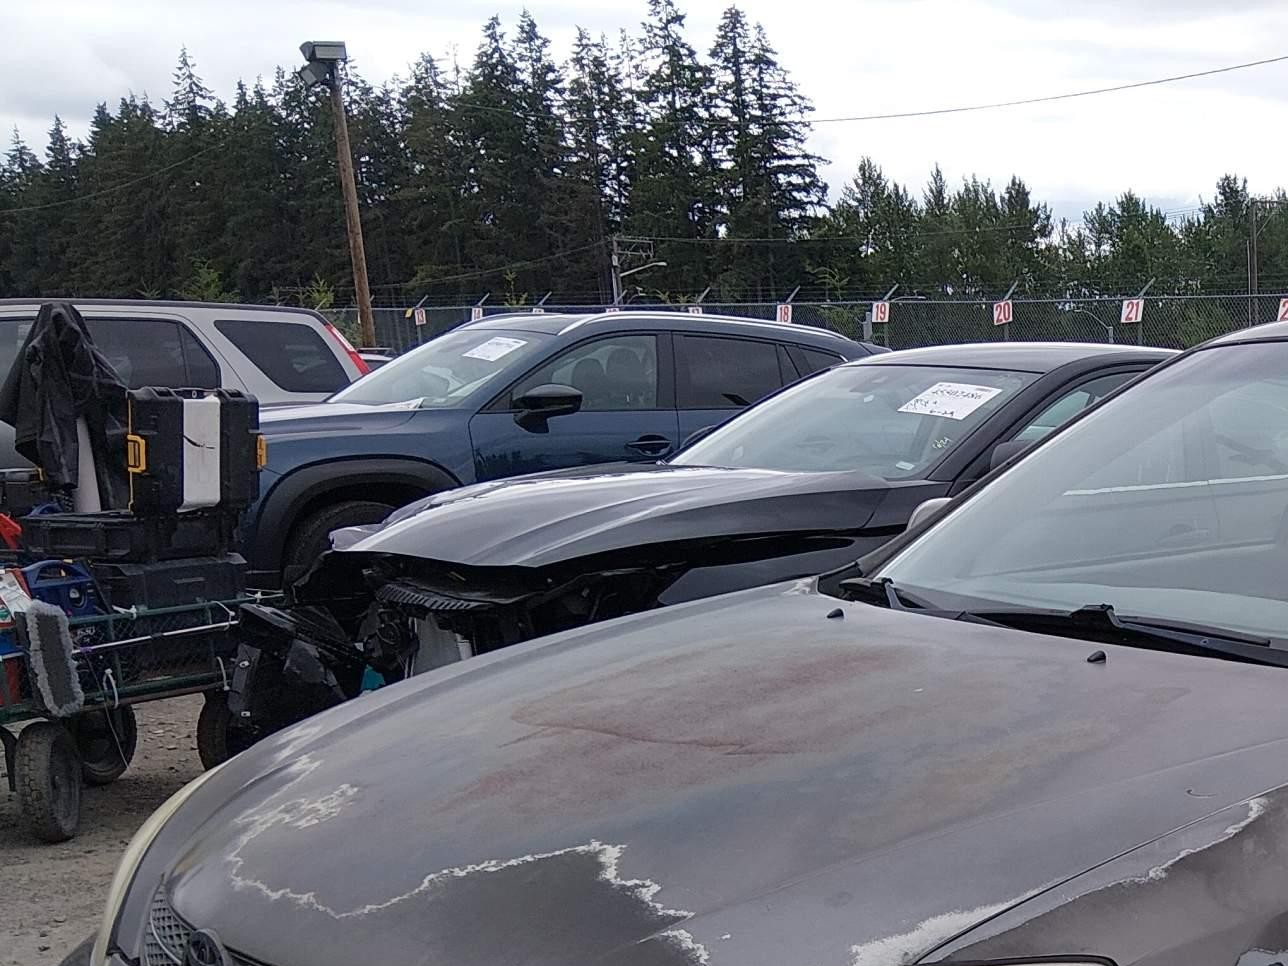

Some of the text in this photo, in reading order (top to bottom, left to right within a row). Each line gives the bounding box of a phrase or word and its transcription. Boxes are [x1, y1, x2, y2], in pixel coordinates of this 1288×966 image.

[779, 305, 790, 322] 18
[875, 302, 887, 321] 19
[995, 301, 1011, 324] 20
[1124, 301, 1140, 322] 21
